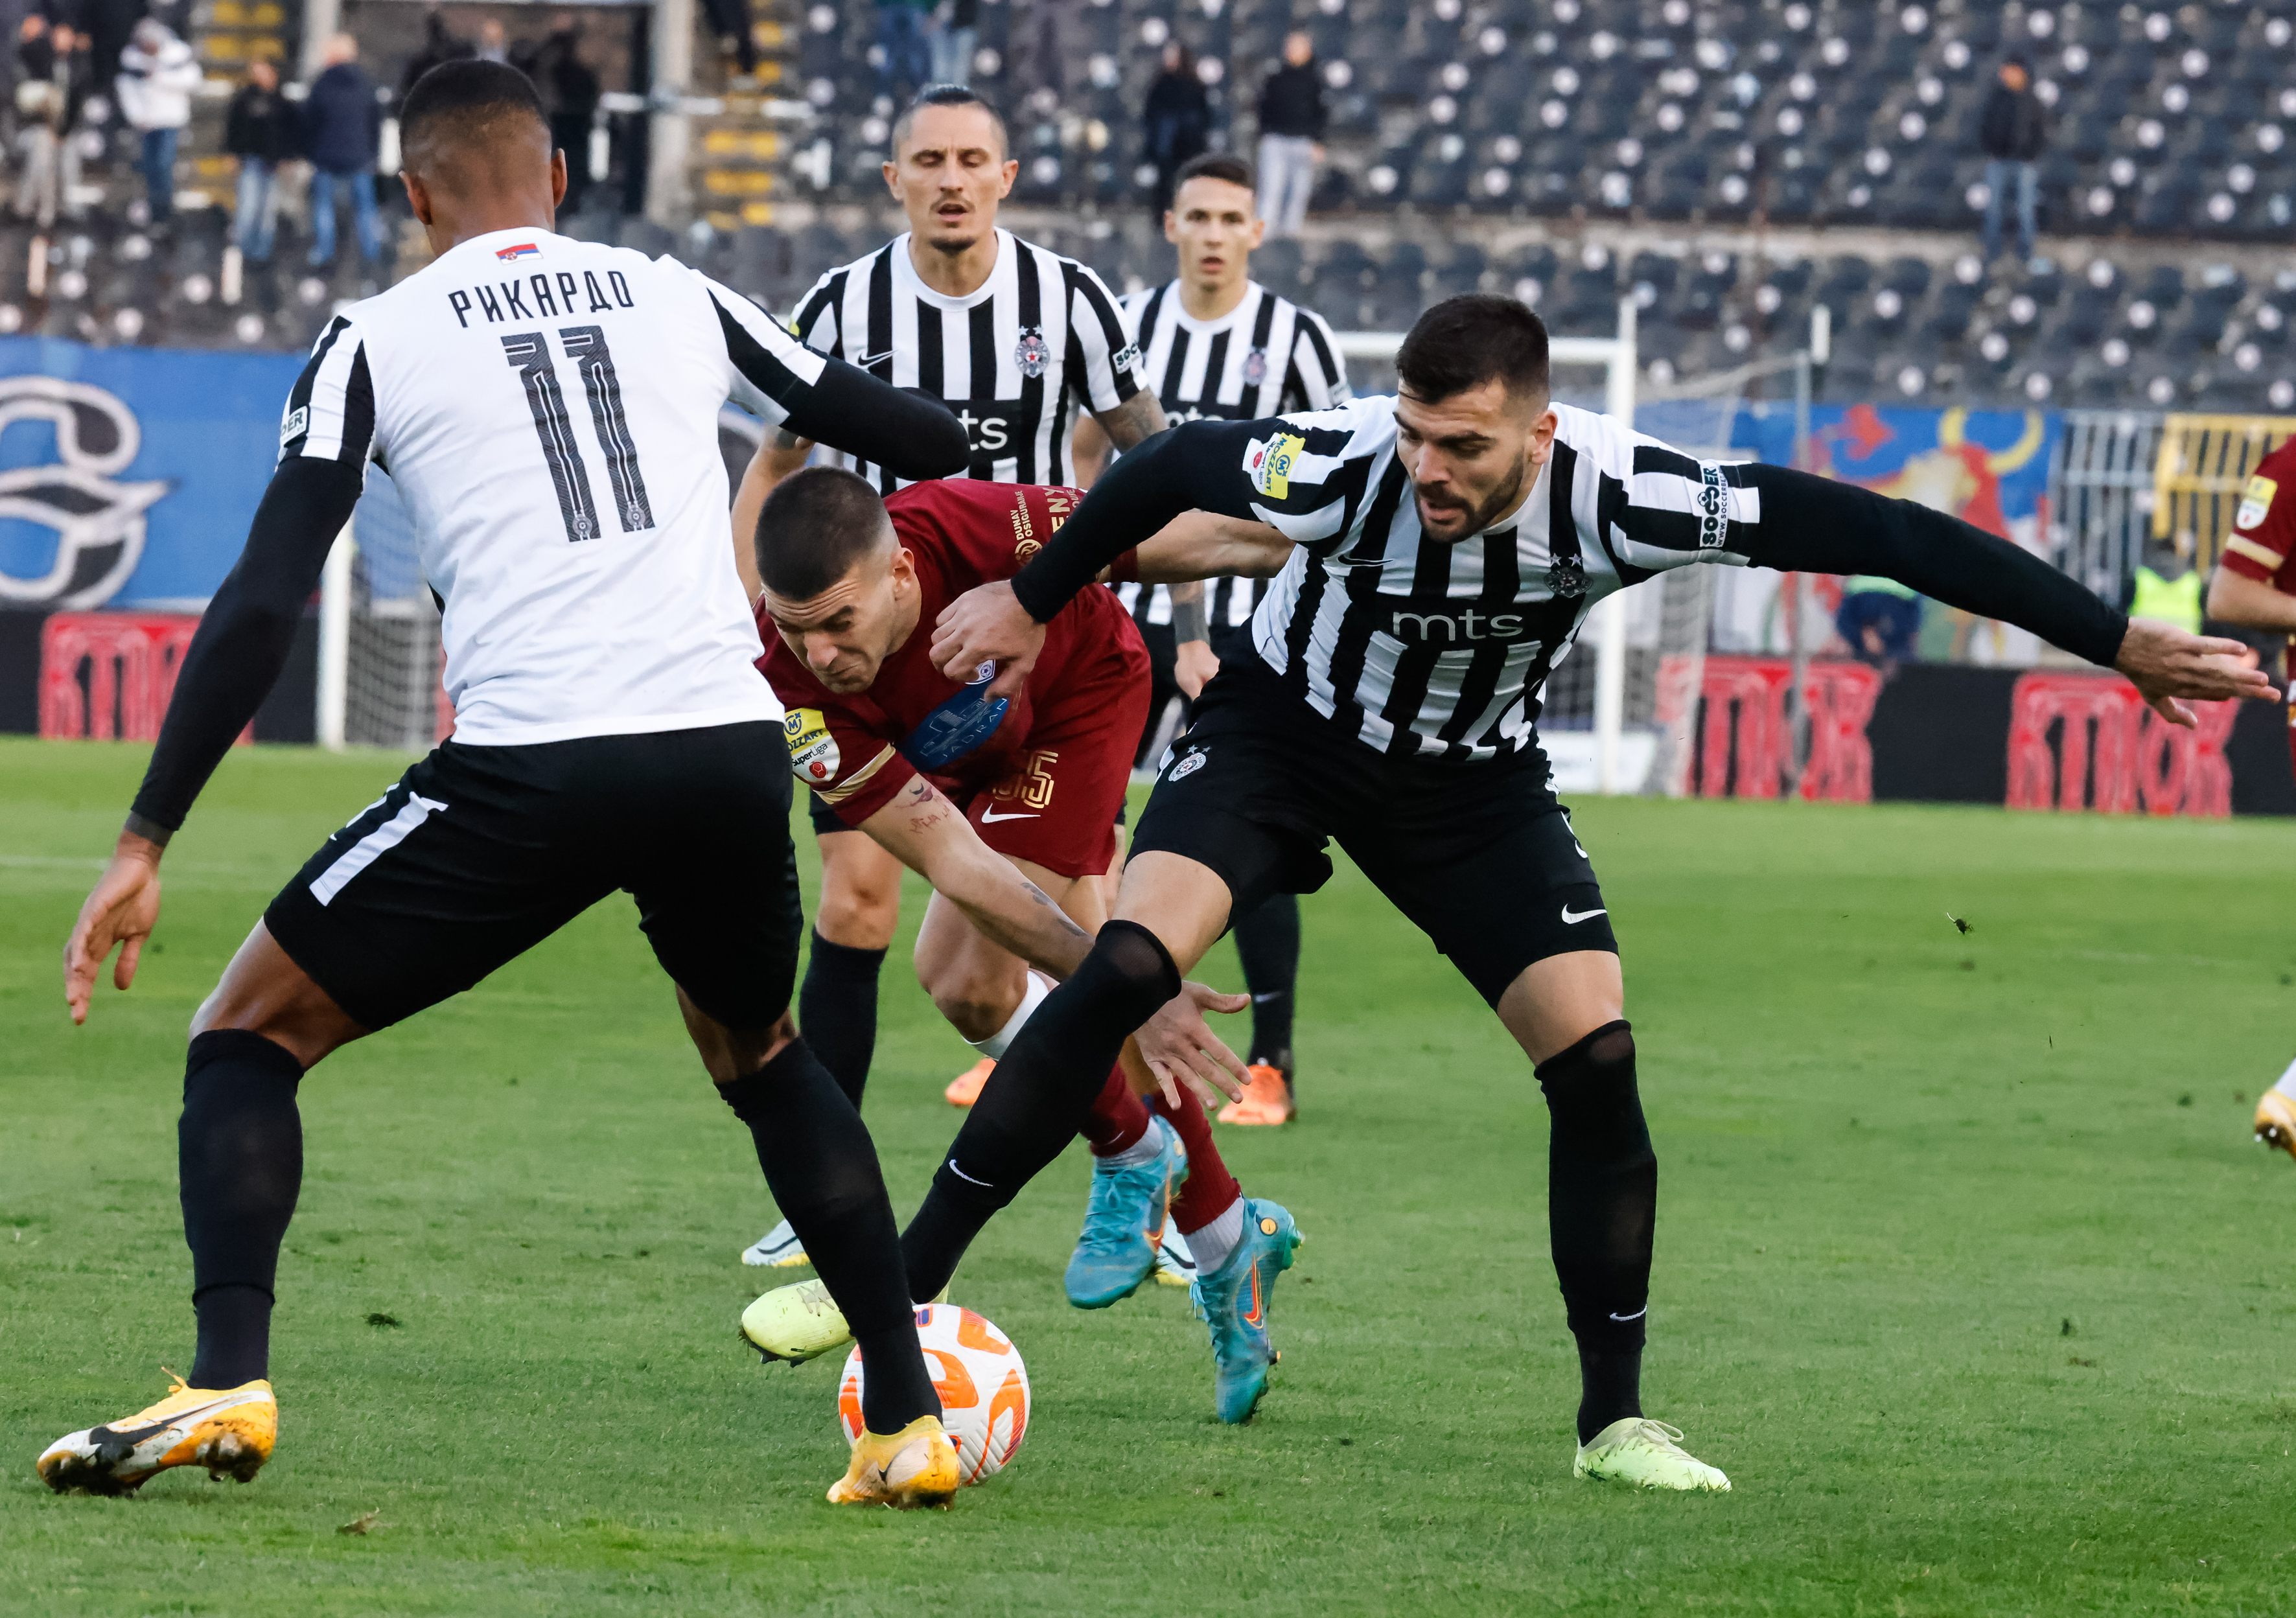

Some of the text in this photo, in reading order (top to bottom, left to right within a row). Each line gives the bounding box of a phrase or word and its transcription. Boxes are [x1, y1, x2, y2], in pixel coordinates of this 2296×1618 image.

[447, 270, 635, 329] РИКАРДО
[500, 325, 656, 543] 11
[957, 408, 1008, 451] ts
[1266, 437, 1288, 492] MOZZART
[1010, 509, 1025, 541] DUNAV
[1014, 490, 1034, 538] OSIGURANJE
[1702, 467, 1721, 545] SOCCER
[1391, 608, 1525, 642] mts
[787, 728, 824, 752] OZZART
[791, 743, 828, 767] SuperLiga
